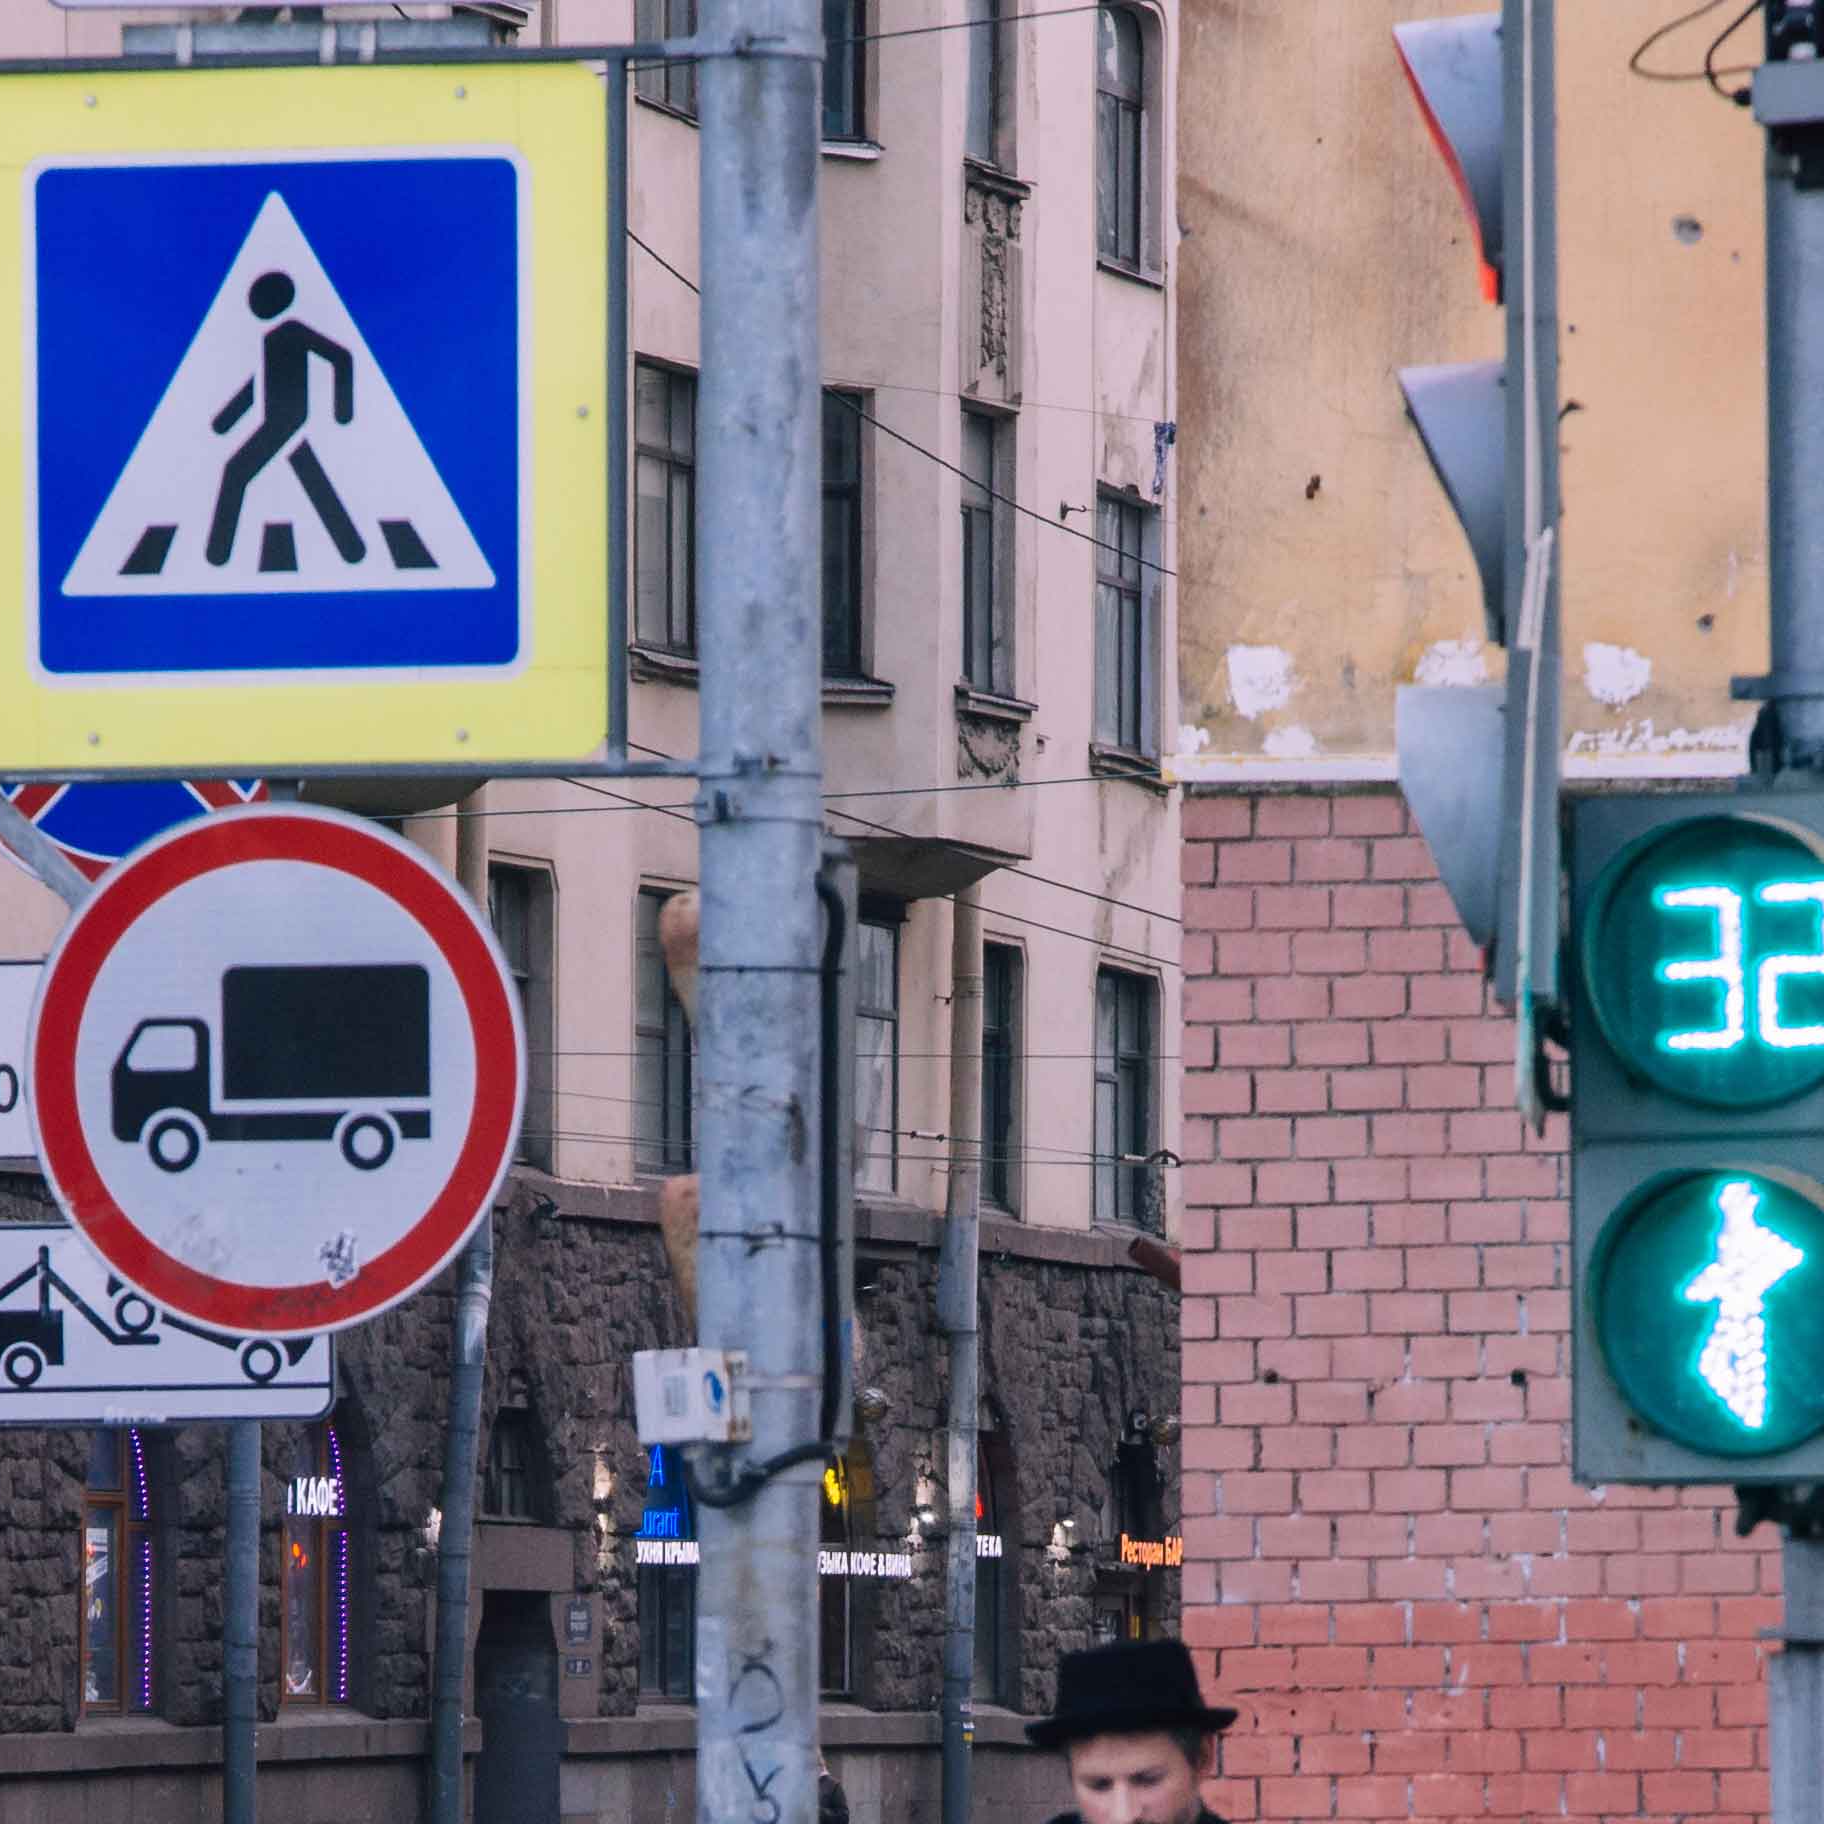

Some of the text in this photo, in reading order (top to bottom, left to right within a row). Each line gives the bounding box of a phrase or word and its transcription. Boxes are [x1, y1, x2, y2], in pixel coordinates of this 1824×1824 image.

[296, 1476, 339, 1516] КАФЕ
[850, 1552, 877, 1576] КОФЕ
[1121, 1533, 1163, 1572] Ресторан
